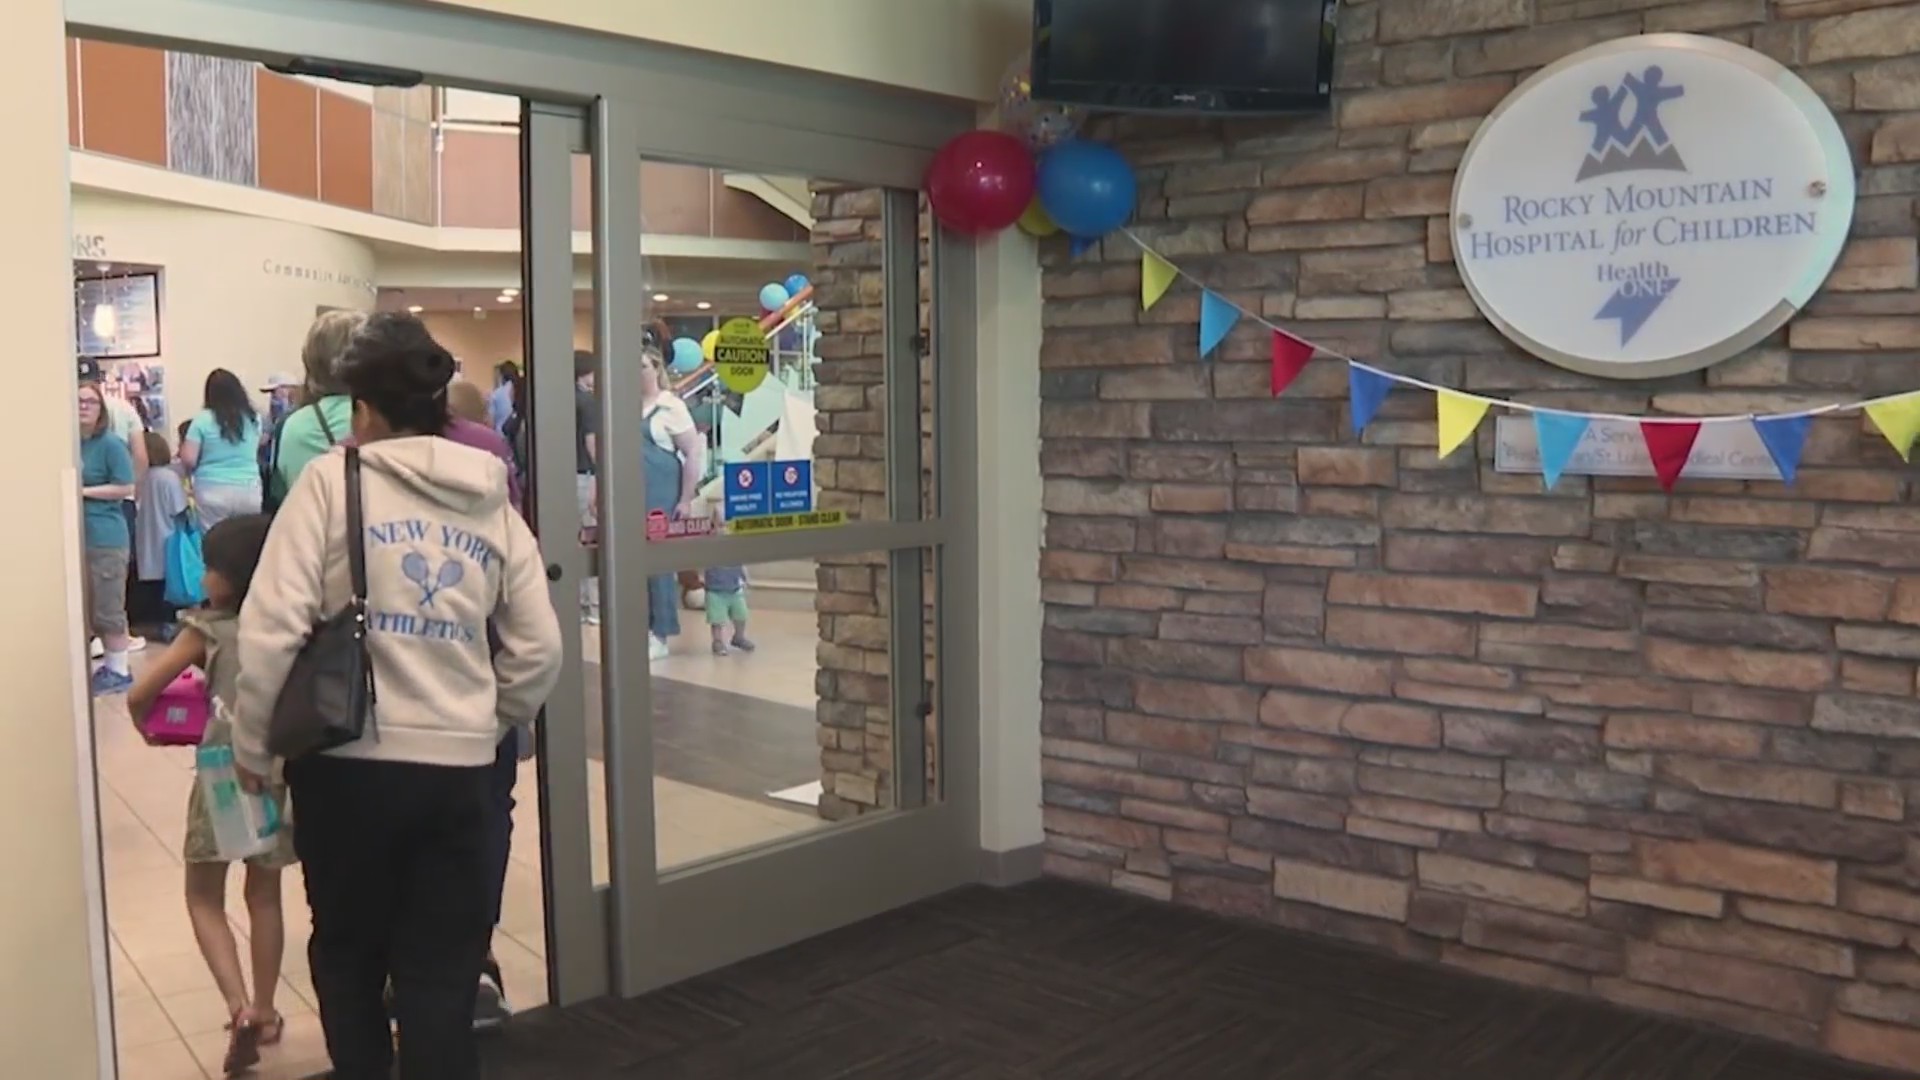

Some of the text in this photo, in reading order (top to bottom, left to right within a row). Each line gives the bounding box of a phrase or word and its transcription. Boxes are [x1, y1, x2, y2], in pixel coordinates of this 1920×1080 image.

[1503, 177, 1774, 225] ROCKY MOUNTAIN
[1471, 211, 1818, 260] HOSPITAL for CHILDREN
[1597, 261, 1670, 284] Health
[1619, 279, 1670, 298] ONE
[717, 348, 767, 362] CAUTION
[1586, 427, 1638, 444] A Serv
[367, 520, 432, 548] NEW
